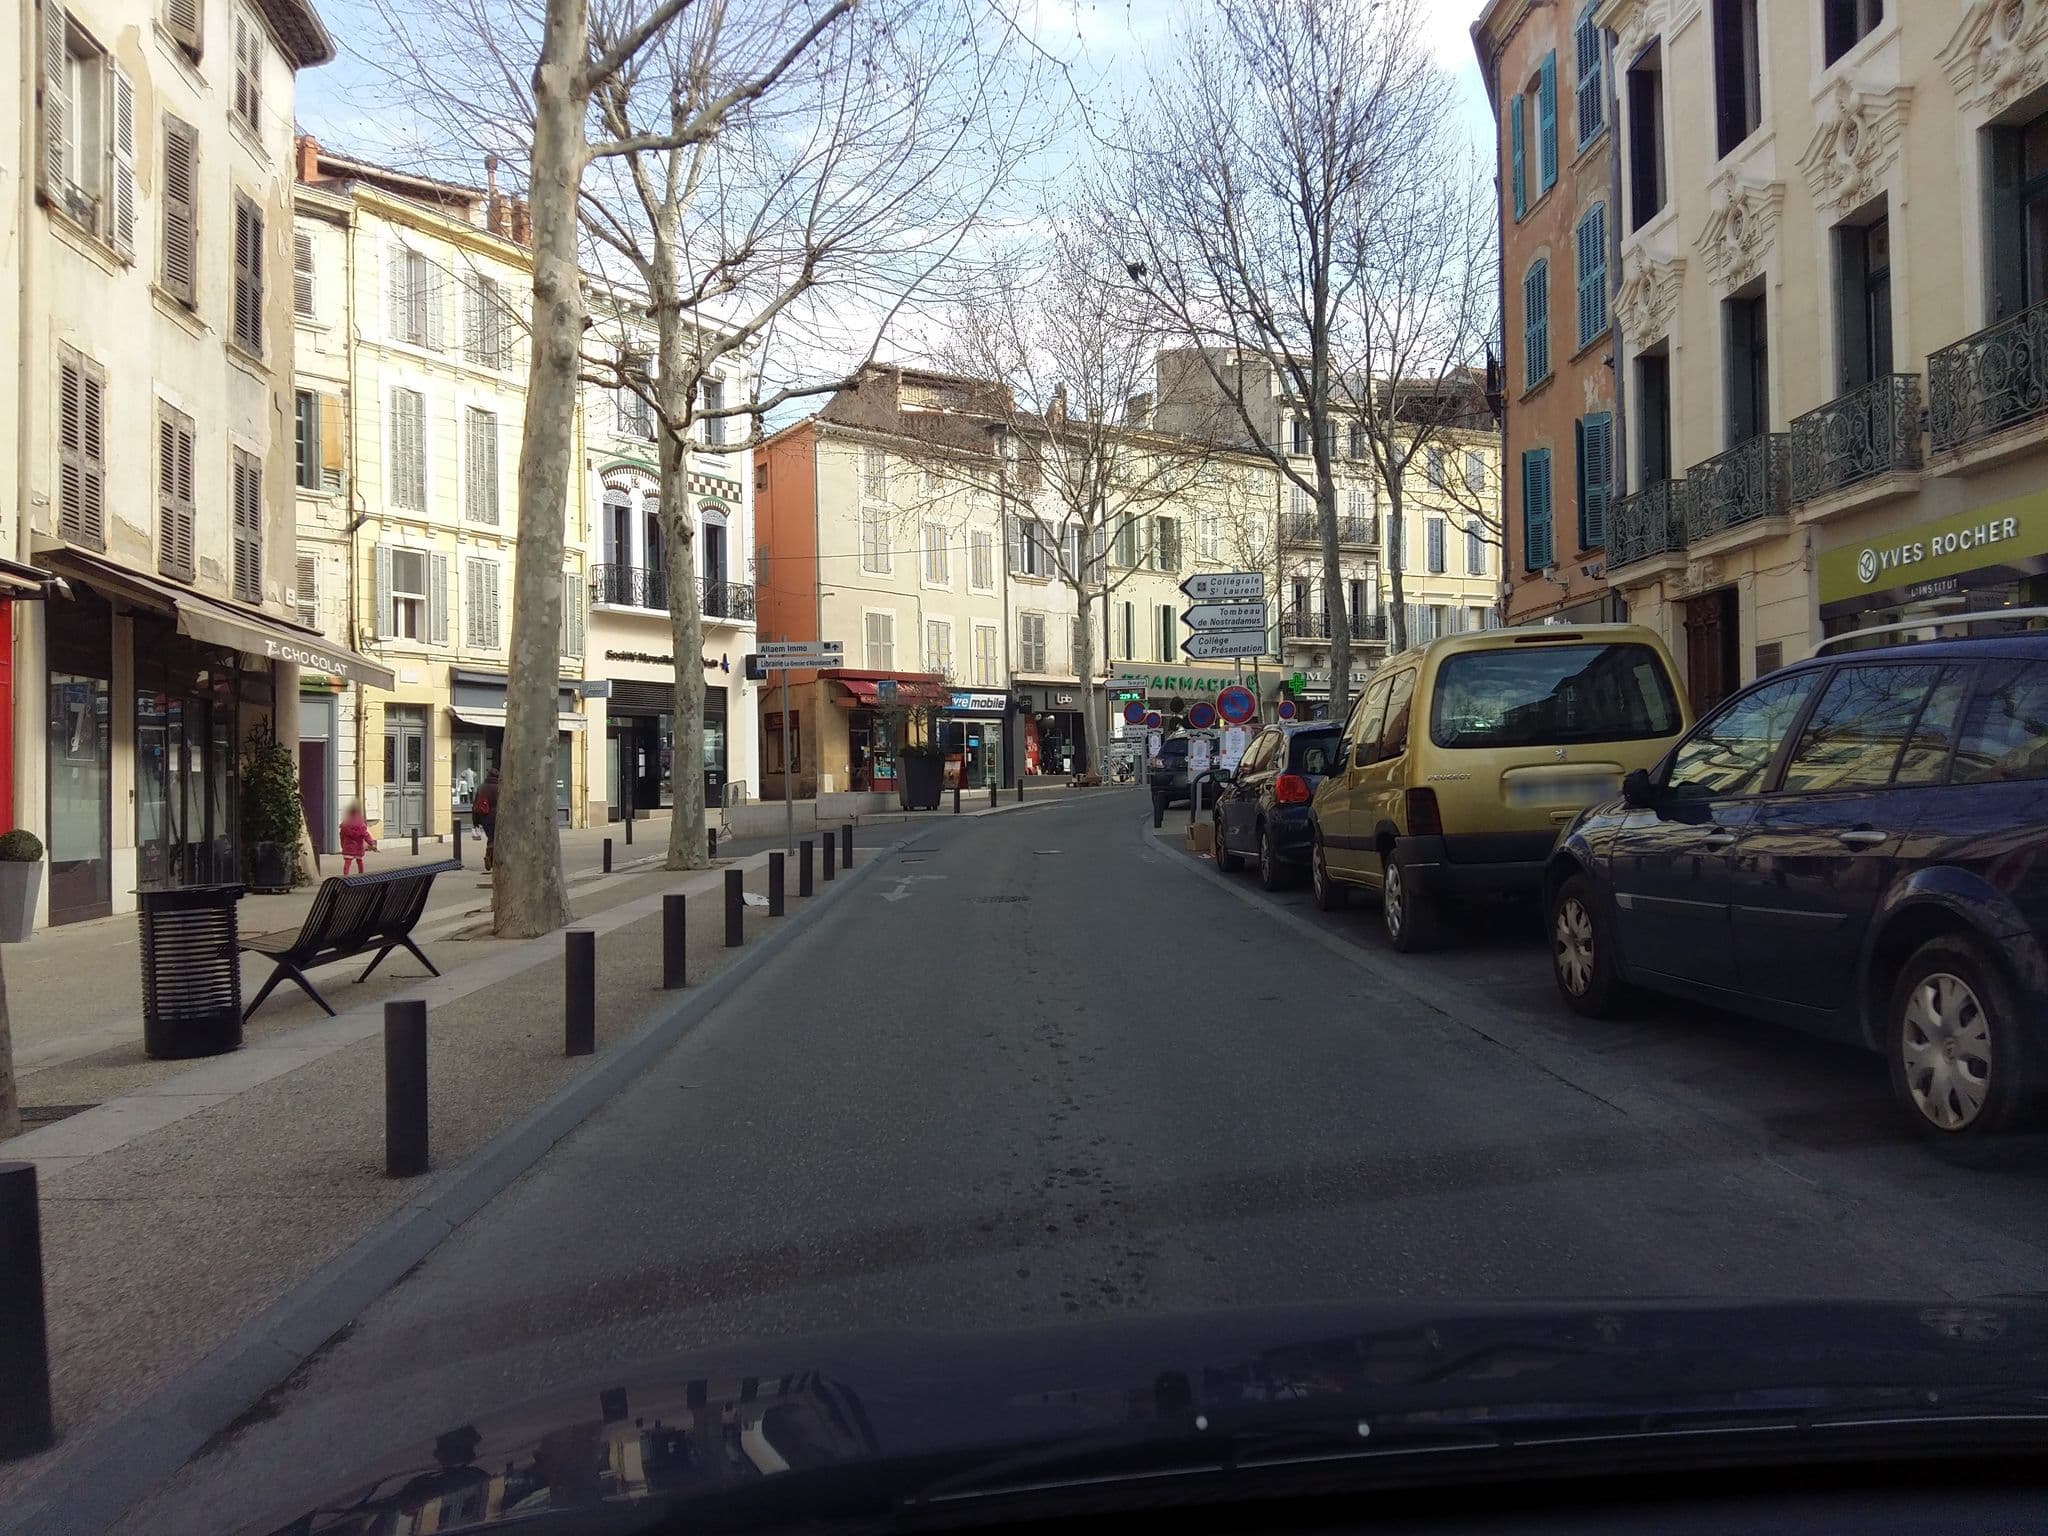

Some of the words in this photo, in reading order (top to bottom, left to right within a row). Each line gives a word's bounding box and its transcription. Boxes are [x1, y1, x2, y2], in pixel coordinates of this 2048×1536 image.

[1880, 543, 1924, 569] YVES
[1932, 517, 2018, 557] ROCHER
[1210, 577, 1259, 587] Collégiale
[1210, 617, 1261, 625] Nostradamus
[1198, 637, 1229, 646] Collège
[1211, 645, 1263, 654] Présentation
[281, 646, 348, 675] CHOCOLAT
[970, 698, 1005, 709] mobile
[1427, 773, 1471, 781] PEUGEOT
